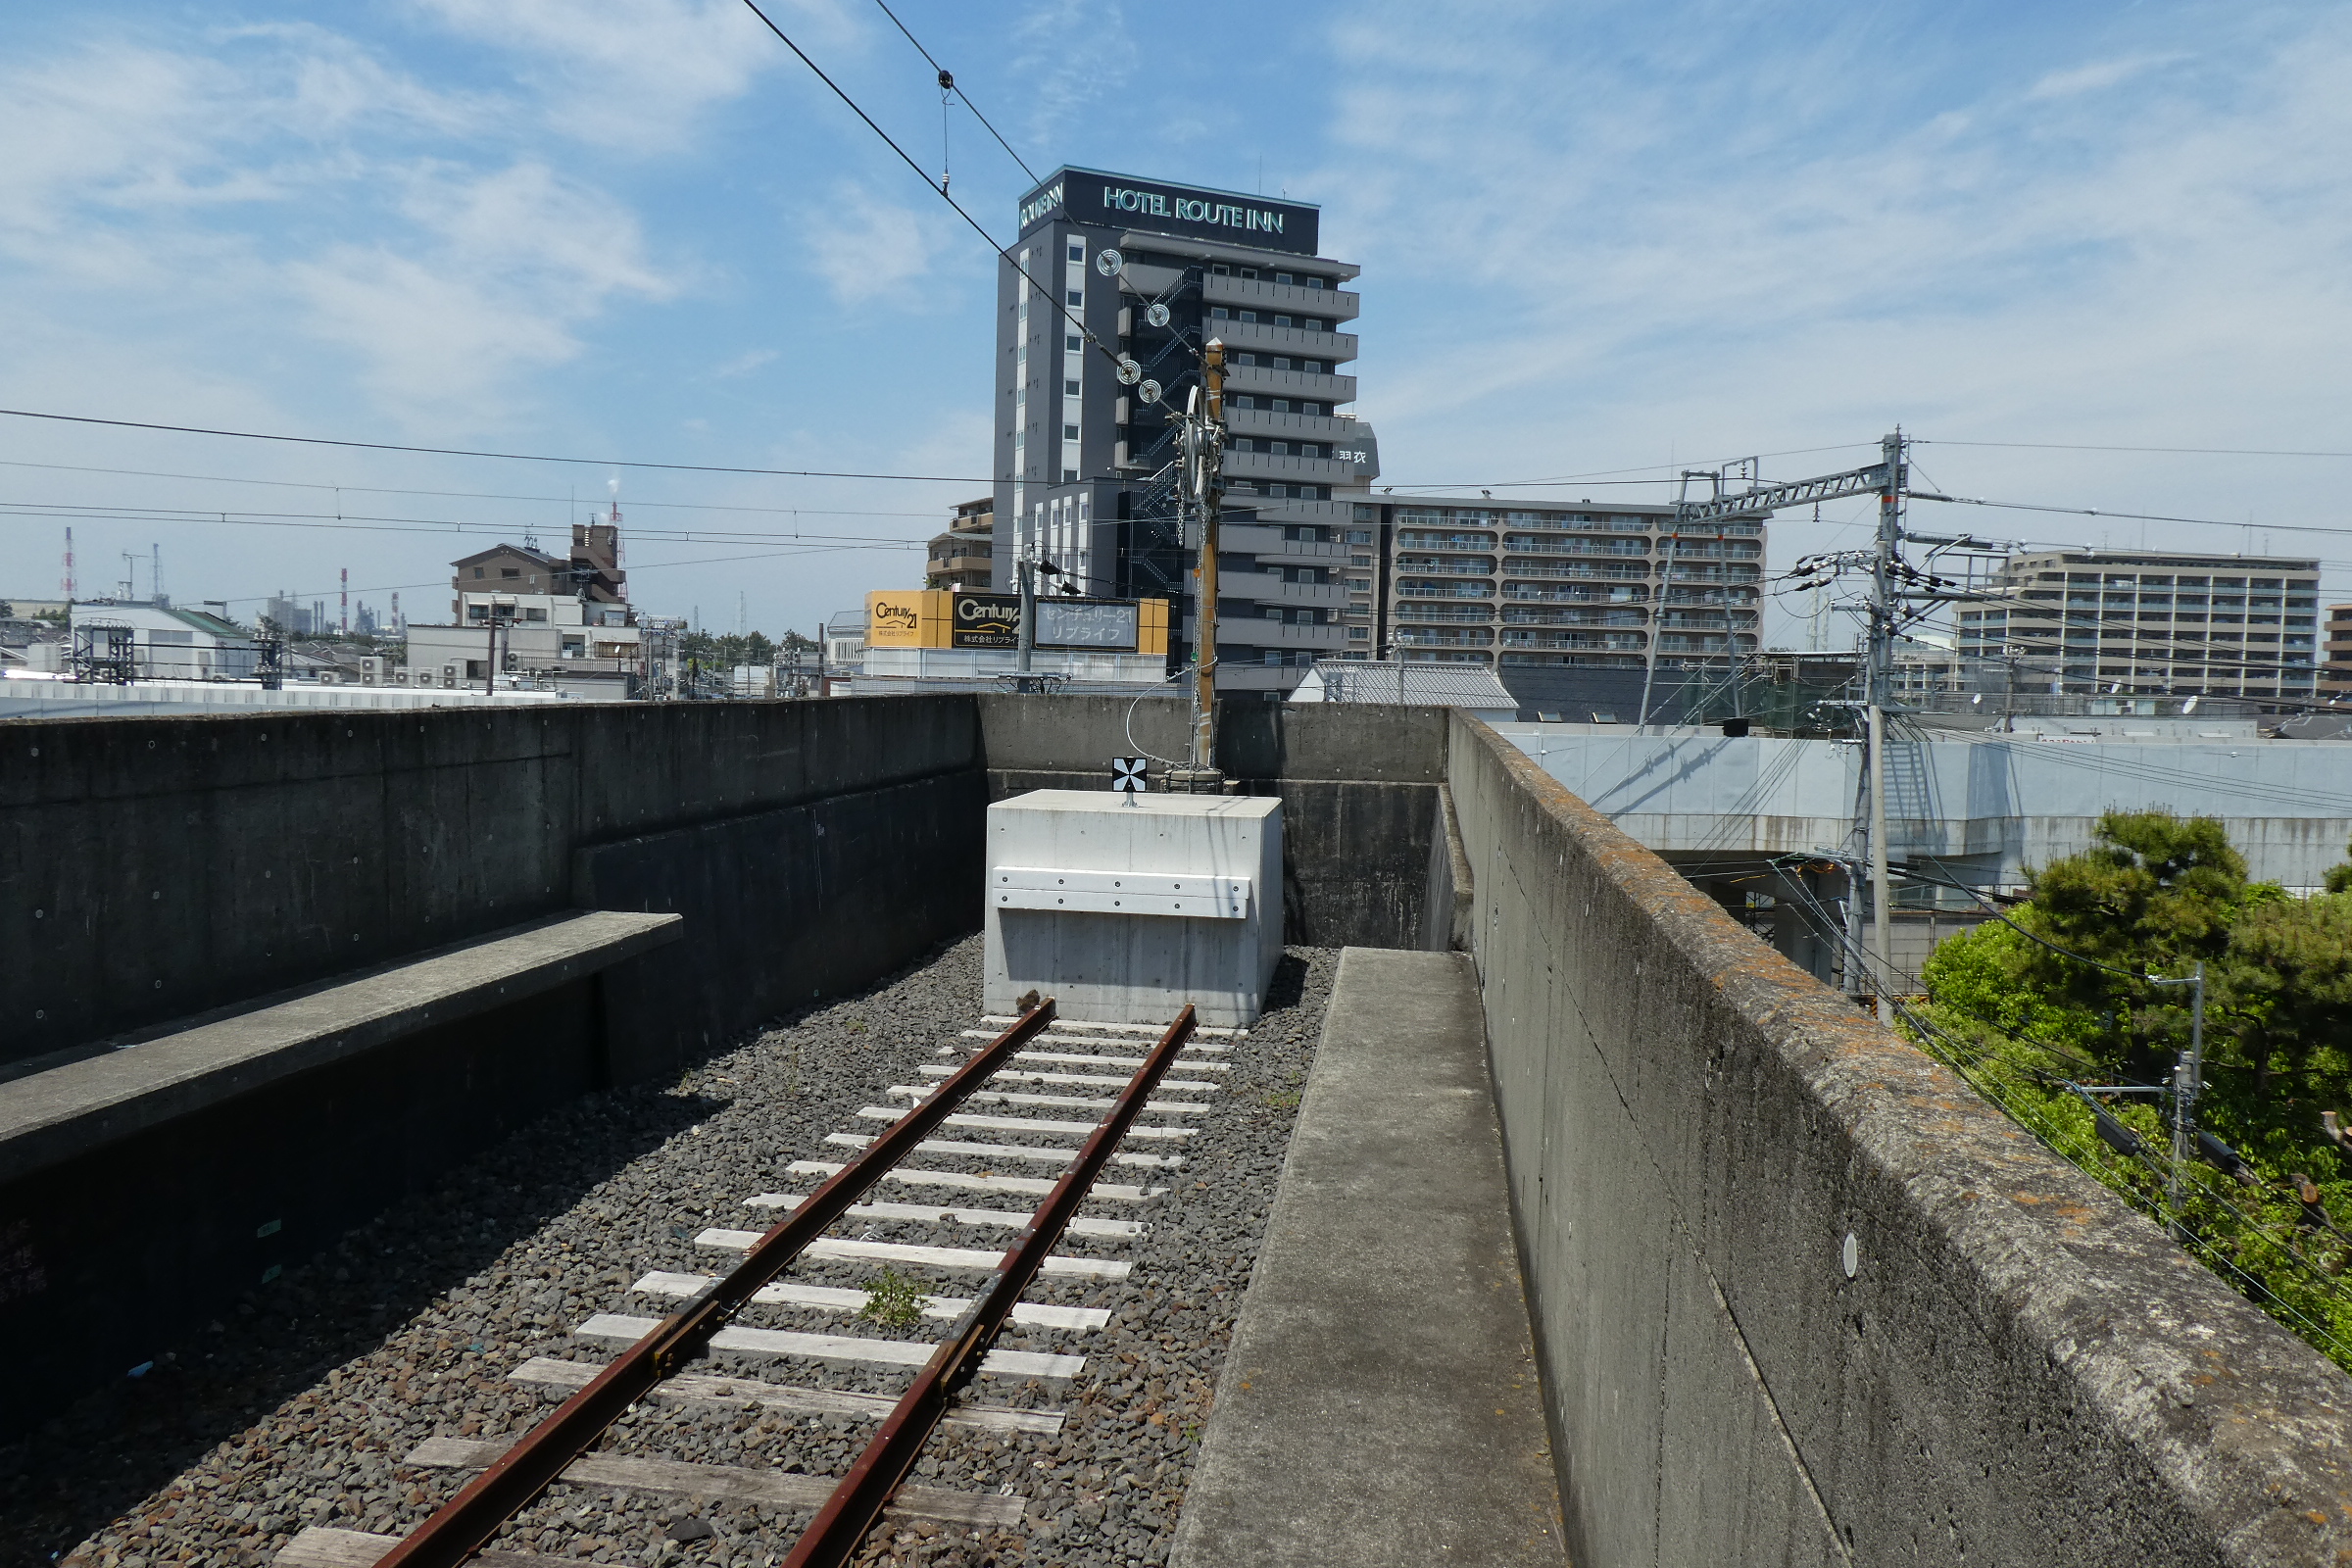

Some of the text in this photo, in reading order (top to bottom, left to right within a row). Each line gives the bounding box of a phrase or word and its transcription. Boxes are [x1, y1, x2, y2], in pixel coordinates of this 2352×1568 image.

[1020, 193, 1046, 230] ROUTE
[1103, 186, 1284, 234] HOTEL ROUTE INN
[876, 602, 910, 619] Century
[906, 613, 917, 629] 21
[958, 599, 1019, 622] Century
[964, 634, 1019, 644] 株式会社リブライ
[1053, 626, 1120, 640] リブライフ
